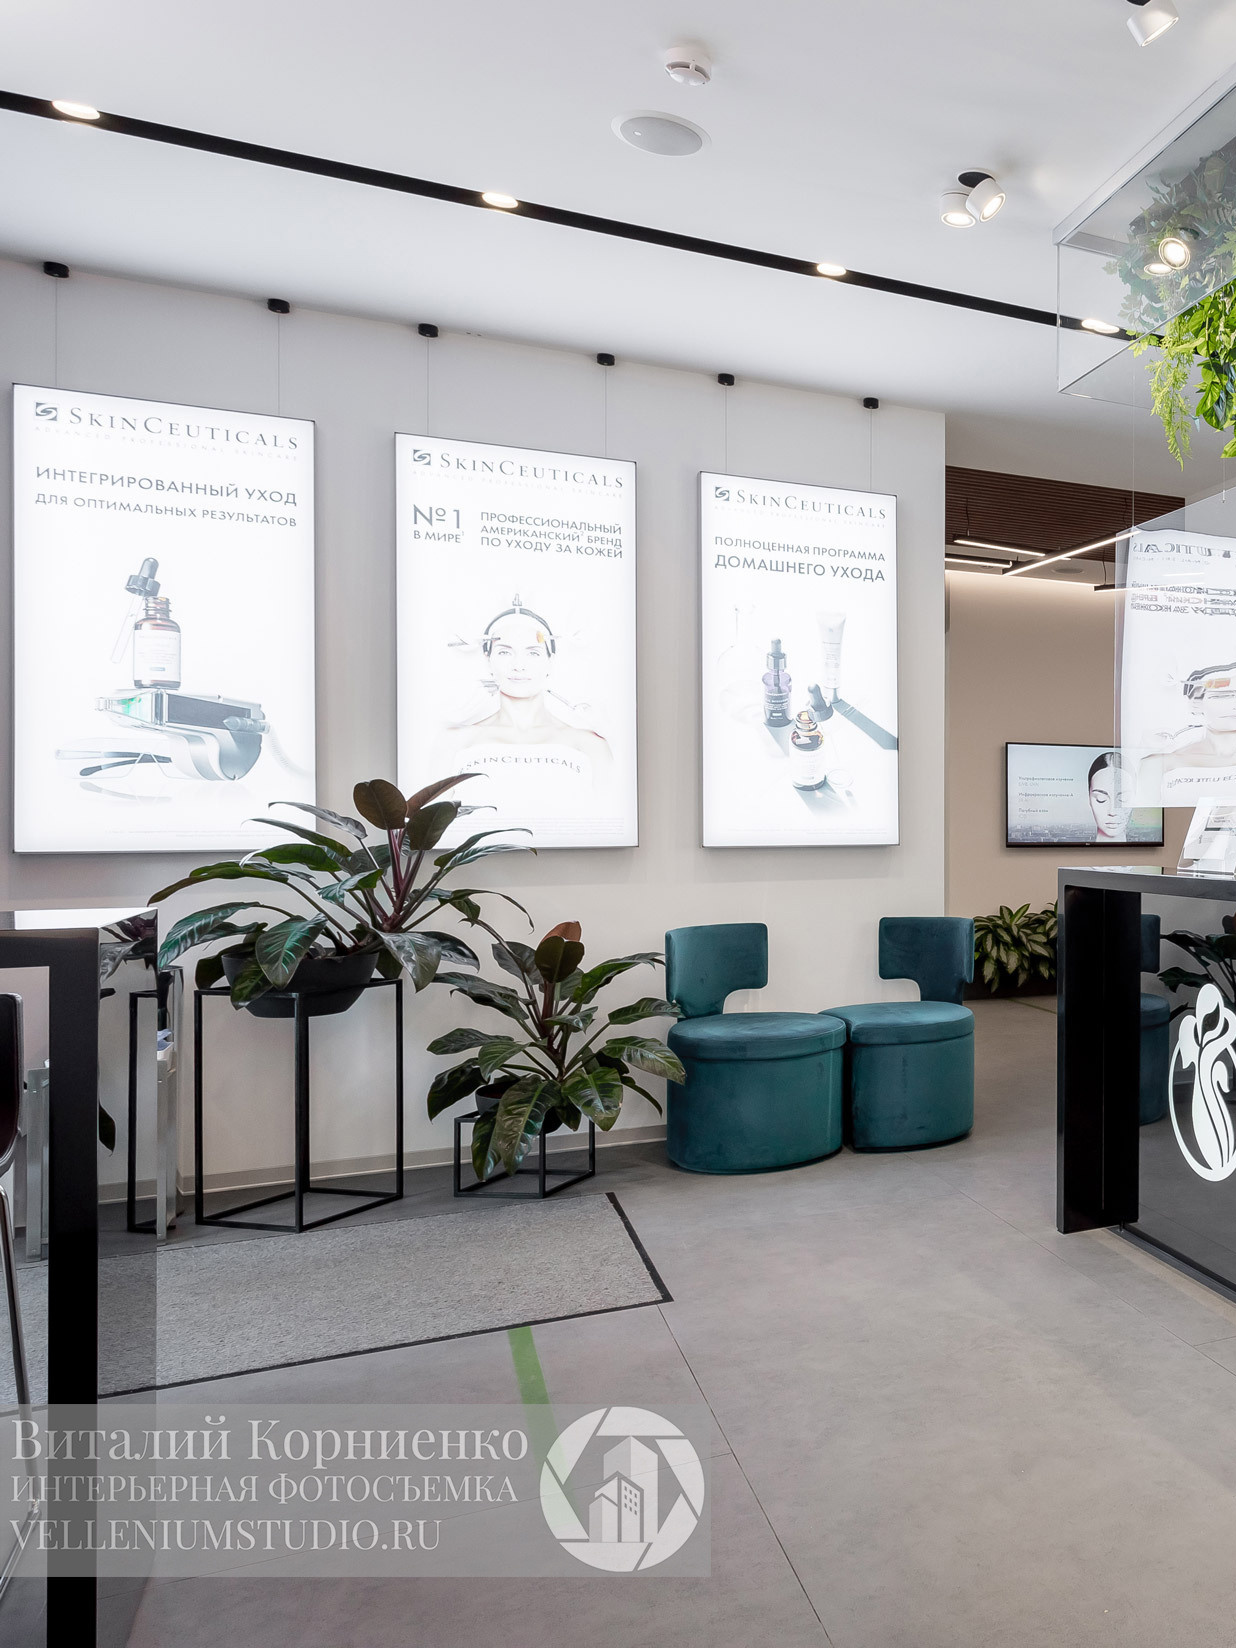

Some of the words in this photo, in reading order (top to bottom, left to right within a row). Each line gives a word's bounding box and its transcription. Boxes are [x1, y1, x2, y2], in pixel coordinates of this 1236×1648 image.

[69, 407, 299, 450] SKINCEUTICALS
[440, 452, 624, 489] SKINCEUTICALS
[35, 466, 239, 499] ИНТЕГРИРОВАННЫЙ
[244, 487, 298, 507] УХОД
[35, 492, 68, 506] ДЛЯ
[73, 497, 197, 518] ОПТИМАЛЬНЫХ
[202, 509, 298, 528] РЕЗУЛЬТАТОВ
[736, 489, 887, 520] SKINCEUTICALS
[413, 530, 421, 540] В
[480, 511, 622, 535] ПРОФЕССИОНАЛЬНЫЙ
[480, 536, 501, 547] ПО
[505, 538, 552, 553] УХОДУ
[556, 543, 572, 554] ЗА
[576, 545, 623, 559] КОЖЕЙ
[587, 535, 623, 549] БРЕНД
[714, 536, 810, 555] ПОЛНОЦЕННАЯ
[813, 546, 886, 562] ПРОГРАММА
[714, 554, 826, 577] ДОМАШНЕГО
[830, 565, 886, 582] УХОДА
